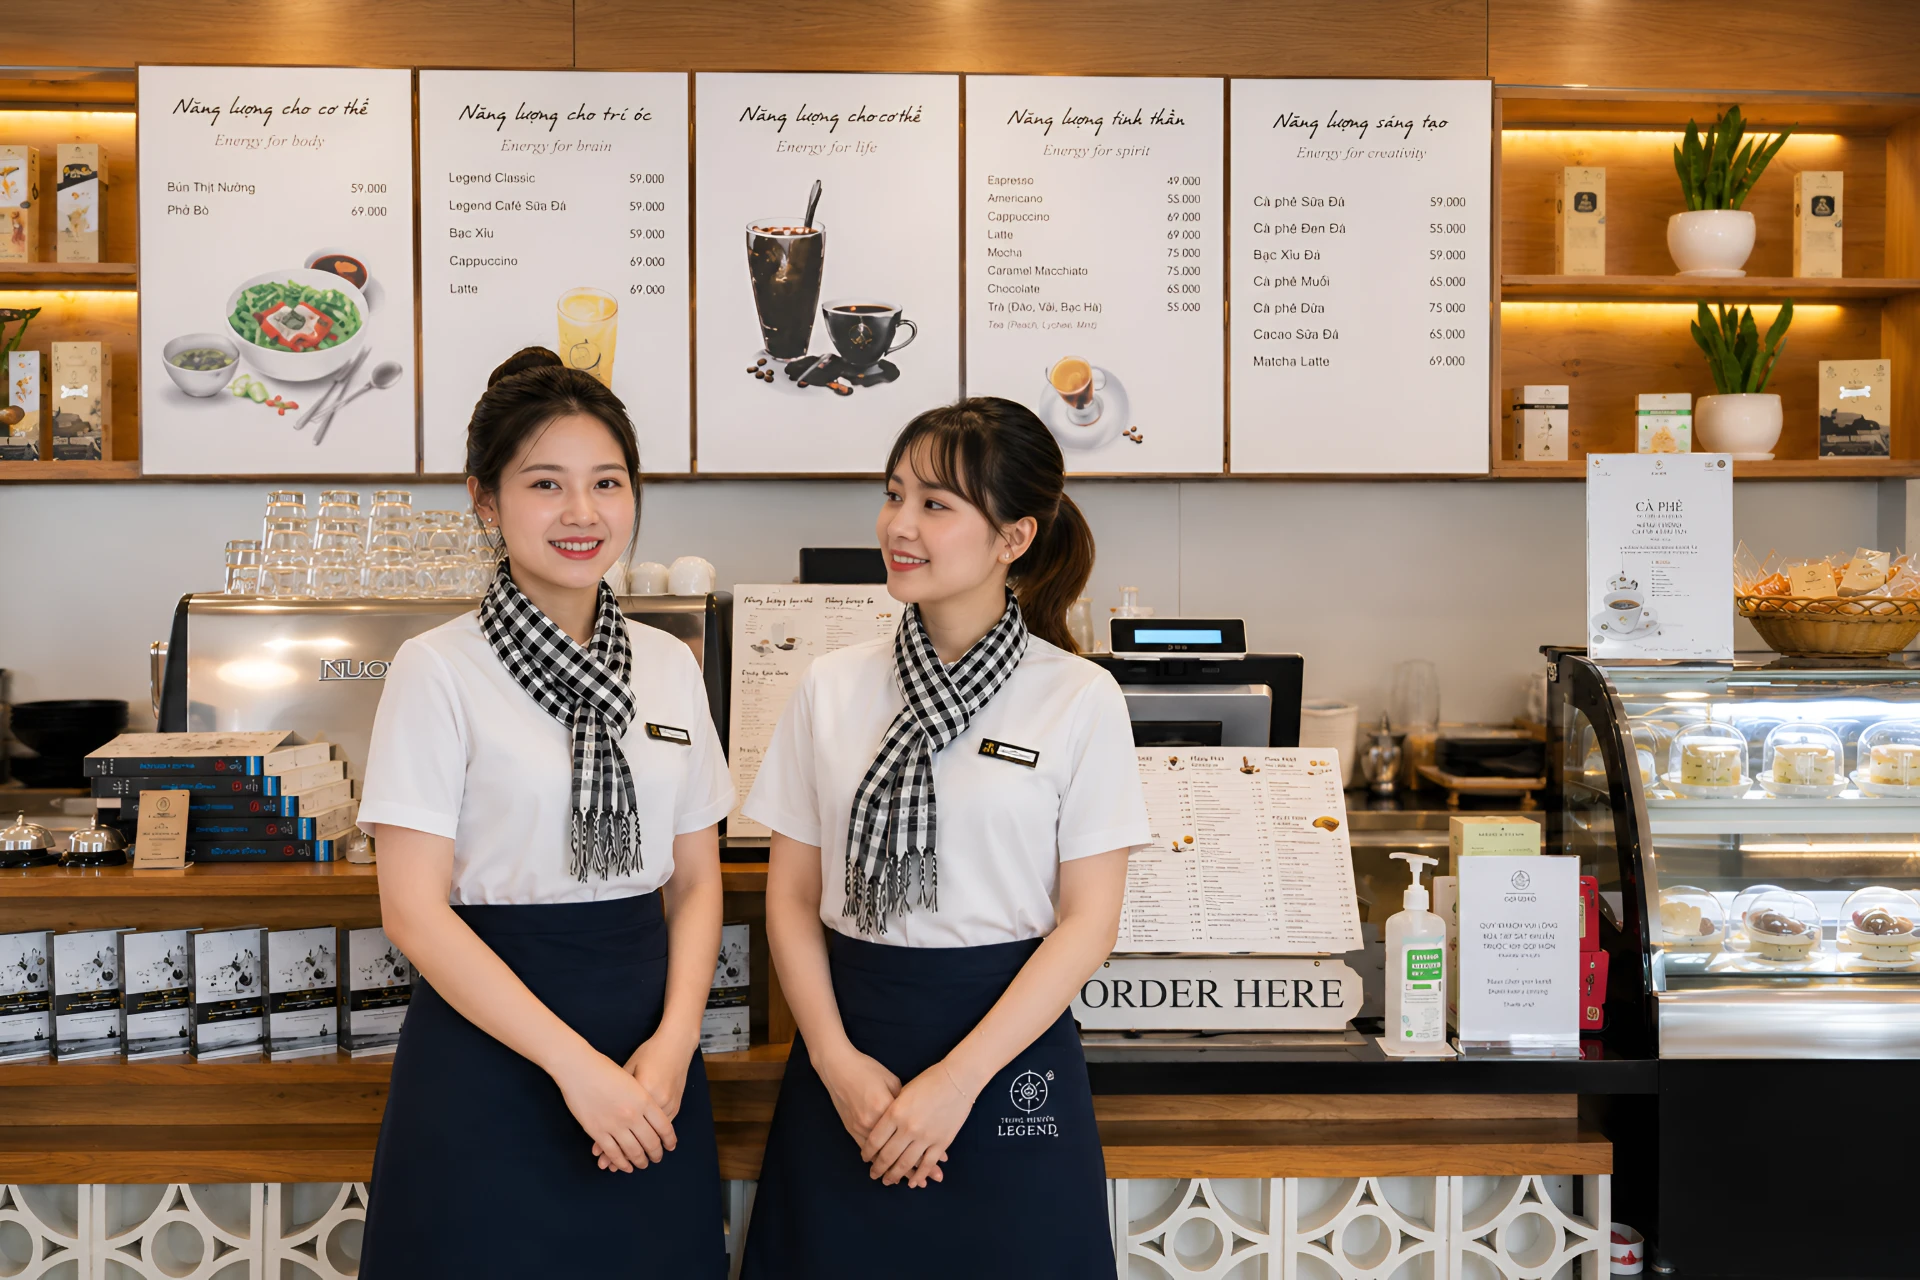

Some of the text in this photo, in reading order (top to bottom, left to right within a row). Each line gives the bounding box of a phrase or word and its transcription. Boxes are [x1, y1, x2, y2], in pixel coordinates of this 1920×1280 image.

[173, 98, 220, 126] Năng
[230, 96, 272, 126] lượng
[282, 98, 311, 114] cho
[319, 106, 338, 114] cơ
[459, 102, 652, 132] Năng lượng cho trí óc
[739, 105, 787, 133] Năng
[796, 104, 839, 133] lượng
[1007, 109, 1053, 136] Năng
[1062, 107, 1103, 136] lượng
[1112, 108, 1142, 125] tinh
[1273, 110, 1448, 139] Năng lượng sáng tạo
[215, 134, 324, 150] Energy for body
[501, 139, 611, 154] Energy for brain
[777, 141, 877, 156] Energy for life
[1044, 144, 1150, 158] Energy for spirit
[1297, 147, 1426, 161] Energy for creativity
[449, 173, 535, 185] Legend Classic
[630, 174, 664, 183] 59.000
[1167, 176, 1200, 185] 49.000
[168, 182, 189, 192] Bún
[351, 184, 386, 193] 59.000
[988, 194, 1042, 203] Americano
[1168, 194, 1200, 203] 55.000
[1431, 197, 1465, 207] 59.000
[194, 205, 208, 215] Bò
[352, 207, 386, 216] 69.000
[450, 200, 491, 213] Legend
[551, 201, 566, 210] Đá
[630, 202, 664, 211] 59.000
[988, 212, 1049, 223] Cappuccino
[1168, 212, 1200, 221] 69.000
[1430, 224, 1465, 233] 55.000
[630, 229, 664, 239] 59.000
[988, 230, 1013, 239] Latte
[1167, 230, 1200, 239] 69.000
[988, 248, 1022, 257] Mocha
[1168, 248, 1200, 257] 75.000
[1430, 250, 1465, 260] 59.000
[450, 256, 517, 267] Cappuccino
[630, 257, 664, 266] 69.000
[988, 266, 1088, 275] Caramel Macchiato
[1167, 266, 1200, 275] 75.000
[1430, 277, 1465, 286] 65.000
[451, 284, 477, 293] Latte
[630, 285, 665, 294] 69.000
[988, 284, 1039, 293] Chocolate
[1167, 284, 1200, 293] 65.000
[1168, 302, 1200, 311] 55.000
[1430, 303, 1465, 313] 75.000
[1254, 329, 1291, 339] Cacao
[1430, 329, 1465, 339] 65.000
[1254, 356, 1329, 366] Matcha Latte
[1430, 356, 1465, 366] 69.000
[319, 658, 391, 681] NUO
[1080, 979, 1344, 1008] ORDER HERE
[997, 1124, 1057, 1136] LEGEND
